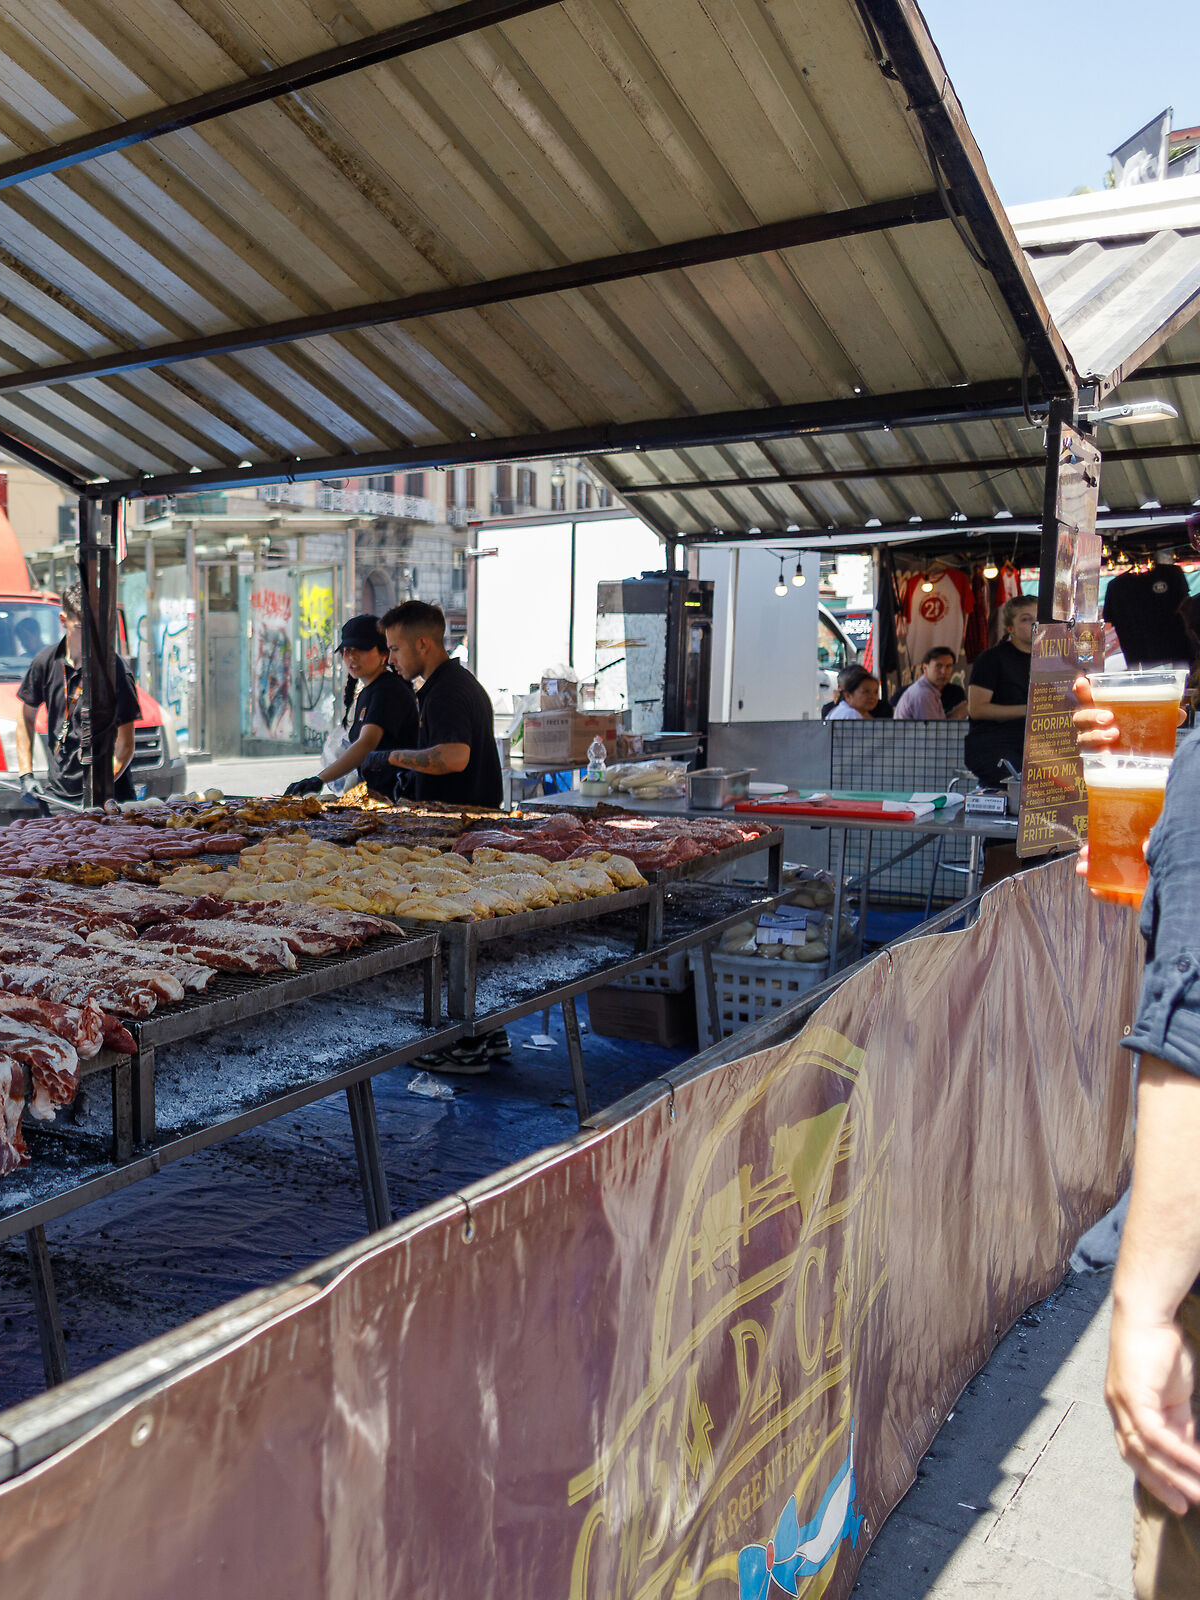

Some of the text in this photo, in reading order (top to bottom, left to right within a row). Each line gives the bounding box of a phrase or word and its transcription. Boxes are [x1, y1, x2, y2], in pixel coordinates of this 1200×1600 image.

[1027, 762, 1078, 781] PIATTO MIX
[1023, 810, 1058, 827] PATATE
[1022, 826, 1056, 842] FRITTE
